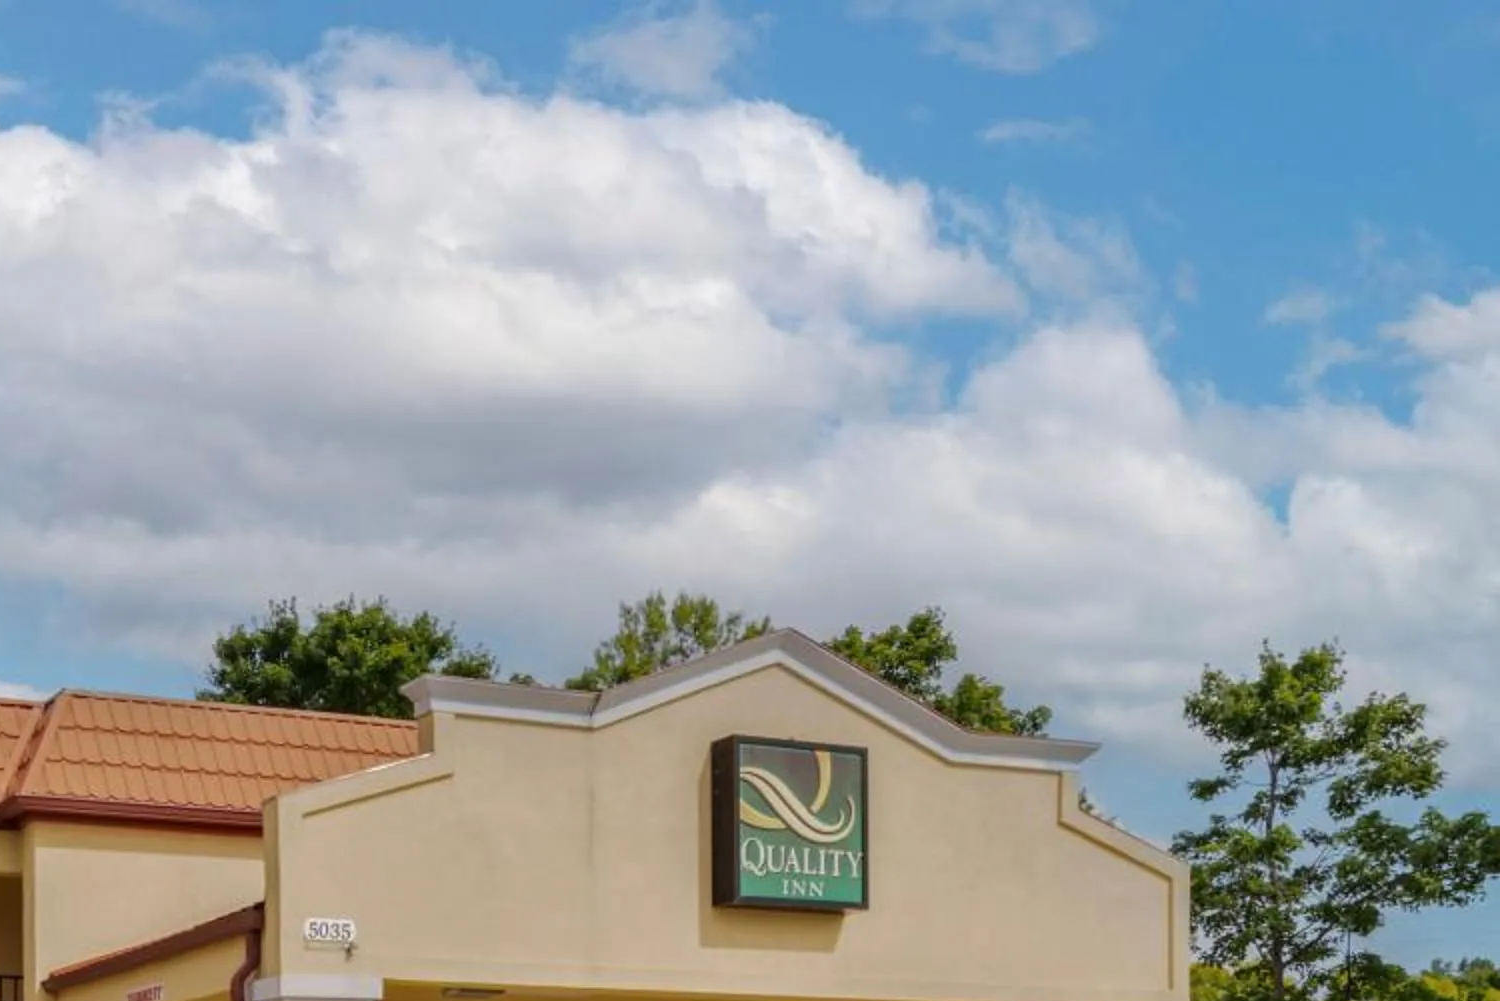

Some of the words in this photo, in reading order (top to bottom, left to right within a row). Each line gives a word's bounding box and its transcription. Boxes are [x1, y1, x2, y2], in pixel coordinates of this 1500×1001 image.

[740, 837, 863, 878] QUALITY
[782, 879, 825, 897] INN
[307, 921, 352, 940] 5035
